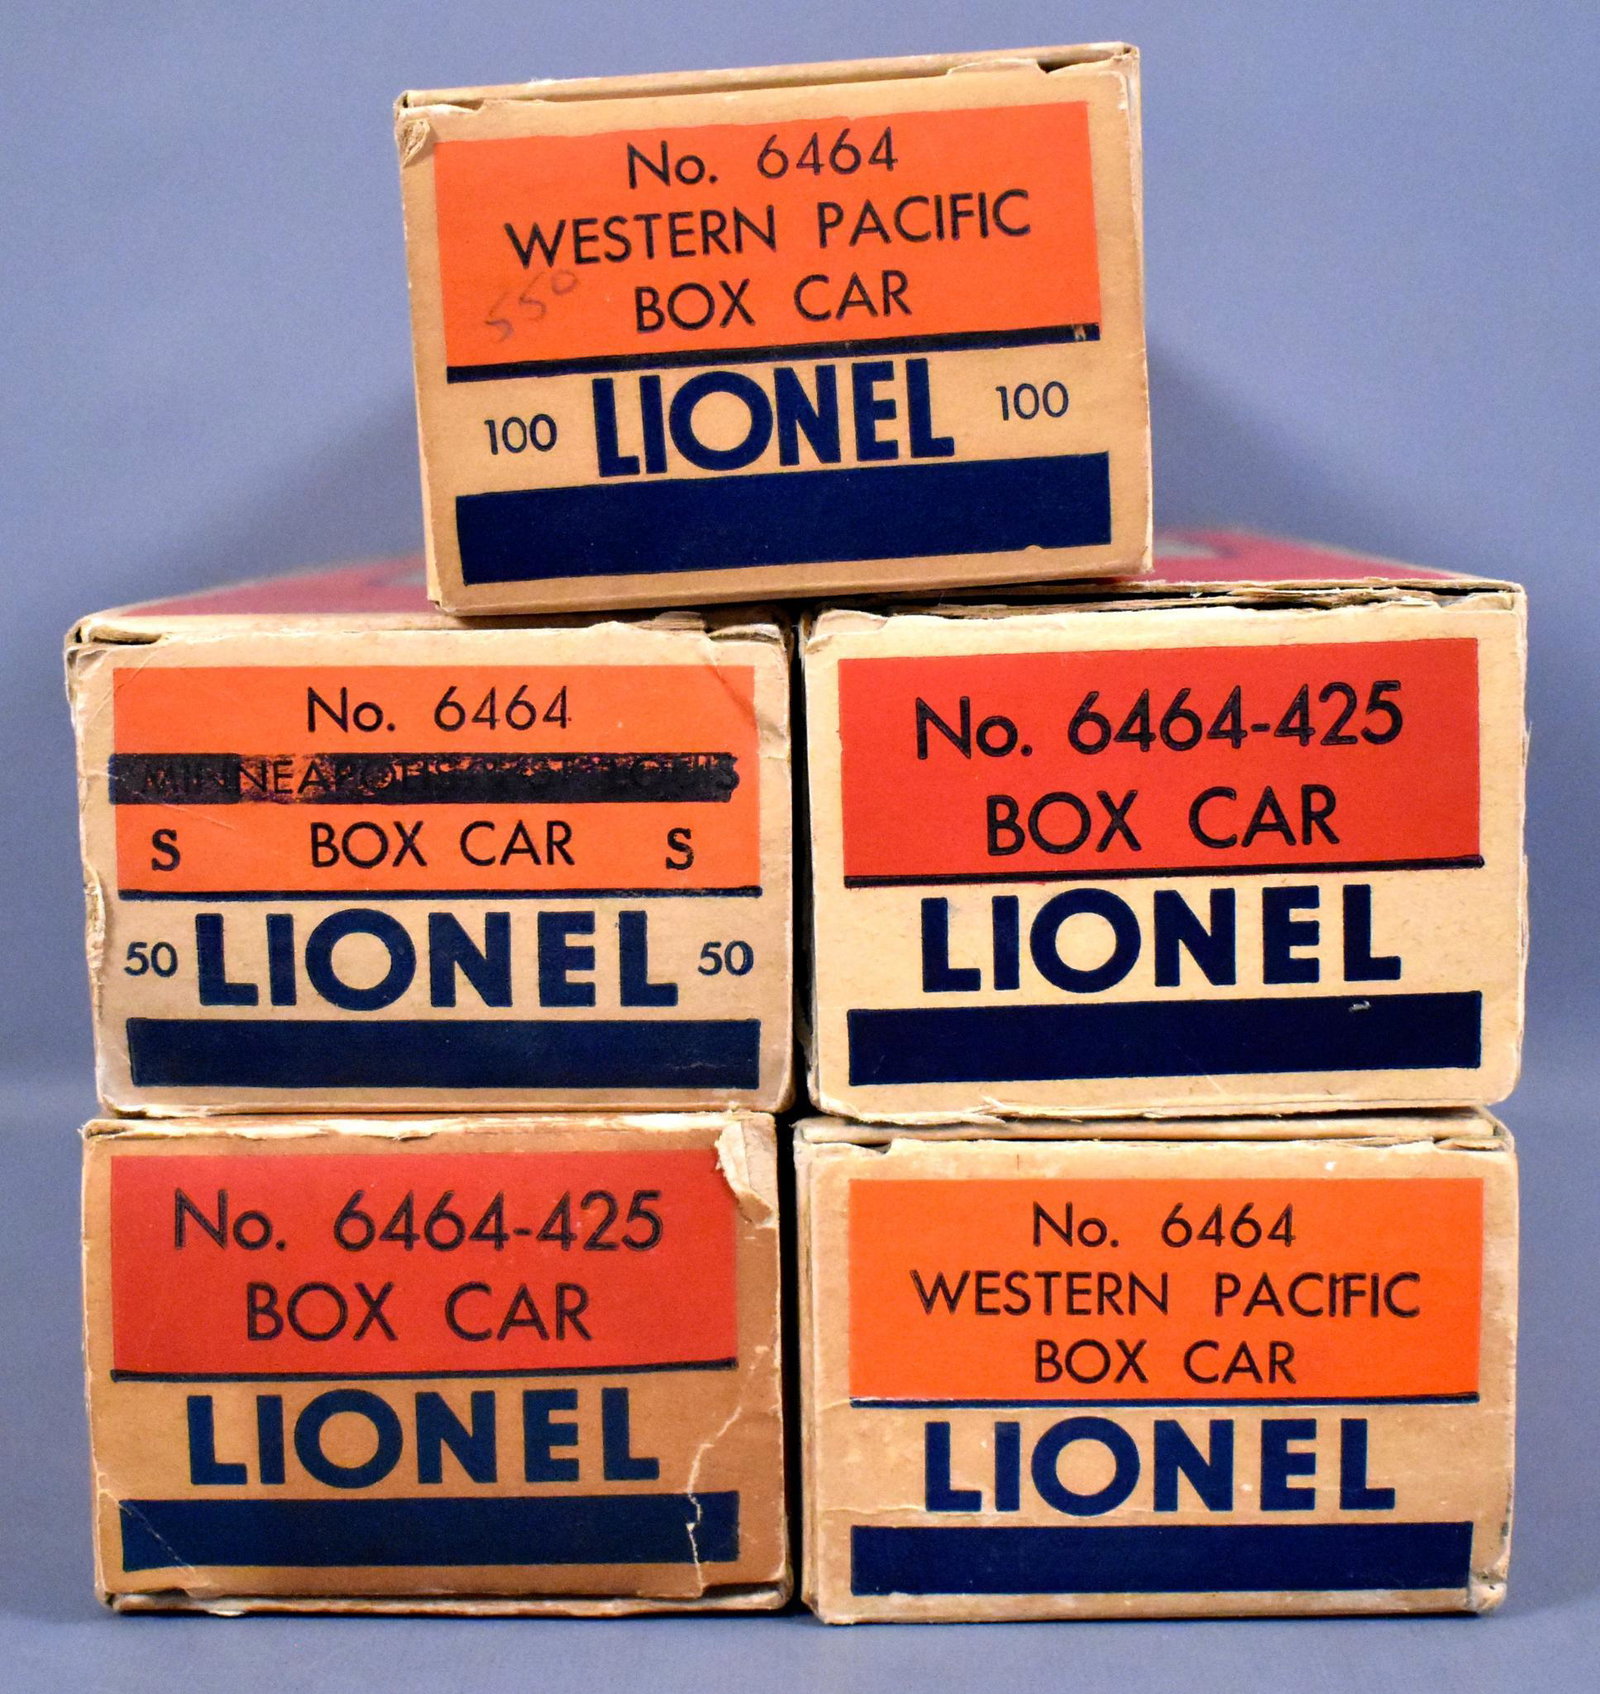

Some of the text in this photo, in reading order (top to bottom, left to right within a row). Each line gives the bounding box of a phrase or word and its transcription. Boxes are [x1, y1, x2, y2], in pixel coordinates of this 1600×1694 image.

[628, 130, 895, 188] No. 6464
[506, 190, 1029, 266] WESTERN PACIFIC
[636, 271, 909, 332] BOX CAR
[485, 359, 1068, 477] 100 LIONEL 100
[308, 686, 566, 732] No. 6464
[916, 680, 1402, 759] No. 6464-425
[152, 821, 693, 871] S BOX CAR S
[987, 785, 1339, 856] BOX CAR
[125, 909, 753, 1011] 50 LIONEL 50
[921, 885, 1402, 993] LIONEL
[175, 1191, 662, 1251] No. 6464-425
[1034, 1205, 1293, 1247] No. 6464
[248, 1283, 591, 1341] BOX CAR
[914, 1272, 1419, 1317] WESTERN PACIFIC
[1037, 1340, 1295, 1383] BOX CAR
[187, 1388, 660, 1489] LIONEL
[925, 1417, 1395, 1516] LIONEL
